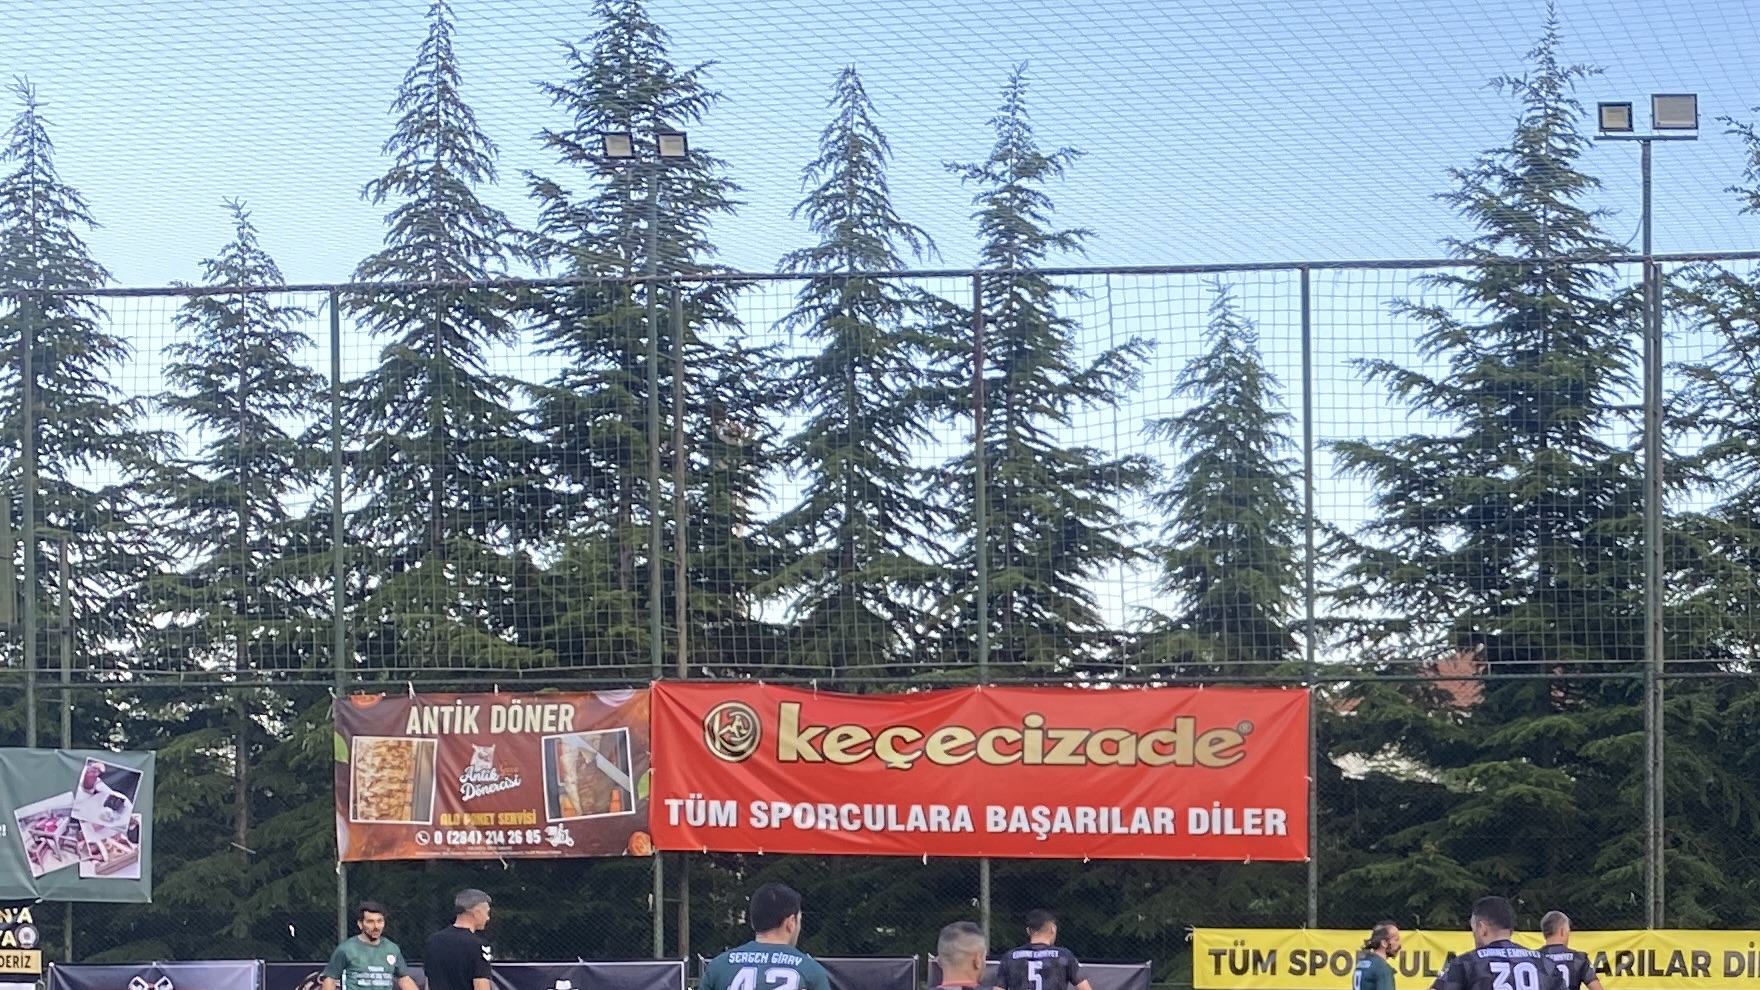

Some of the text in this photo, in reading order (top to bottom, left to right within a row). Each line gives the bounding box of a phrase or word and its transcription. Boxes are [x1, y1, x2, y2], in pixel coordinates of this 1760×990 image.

[406, 699, 575, 735] ANTİK DÖNER
[778, 701, 1246, 770] keçecizade
[459, 765, 499, 783] Antik
[664, 794, 1287, 841] TÜM SPORCULARA BAŞARILAR DİLER
[434, 831, 443, 845] 0
[447, 830, 482, 845] (284)
[485, 830, 505, 846] 214
[508, 830, 523, 844] 26
[728, 951, 803, 966] SERGEN GİRAY
[1207, 940, 1277, 976] TÜM
[1594, 950, 1711, 977] ARILAR
